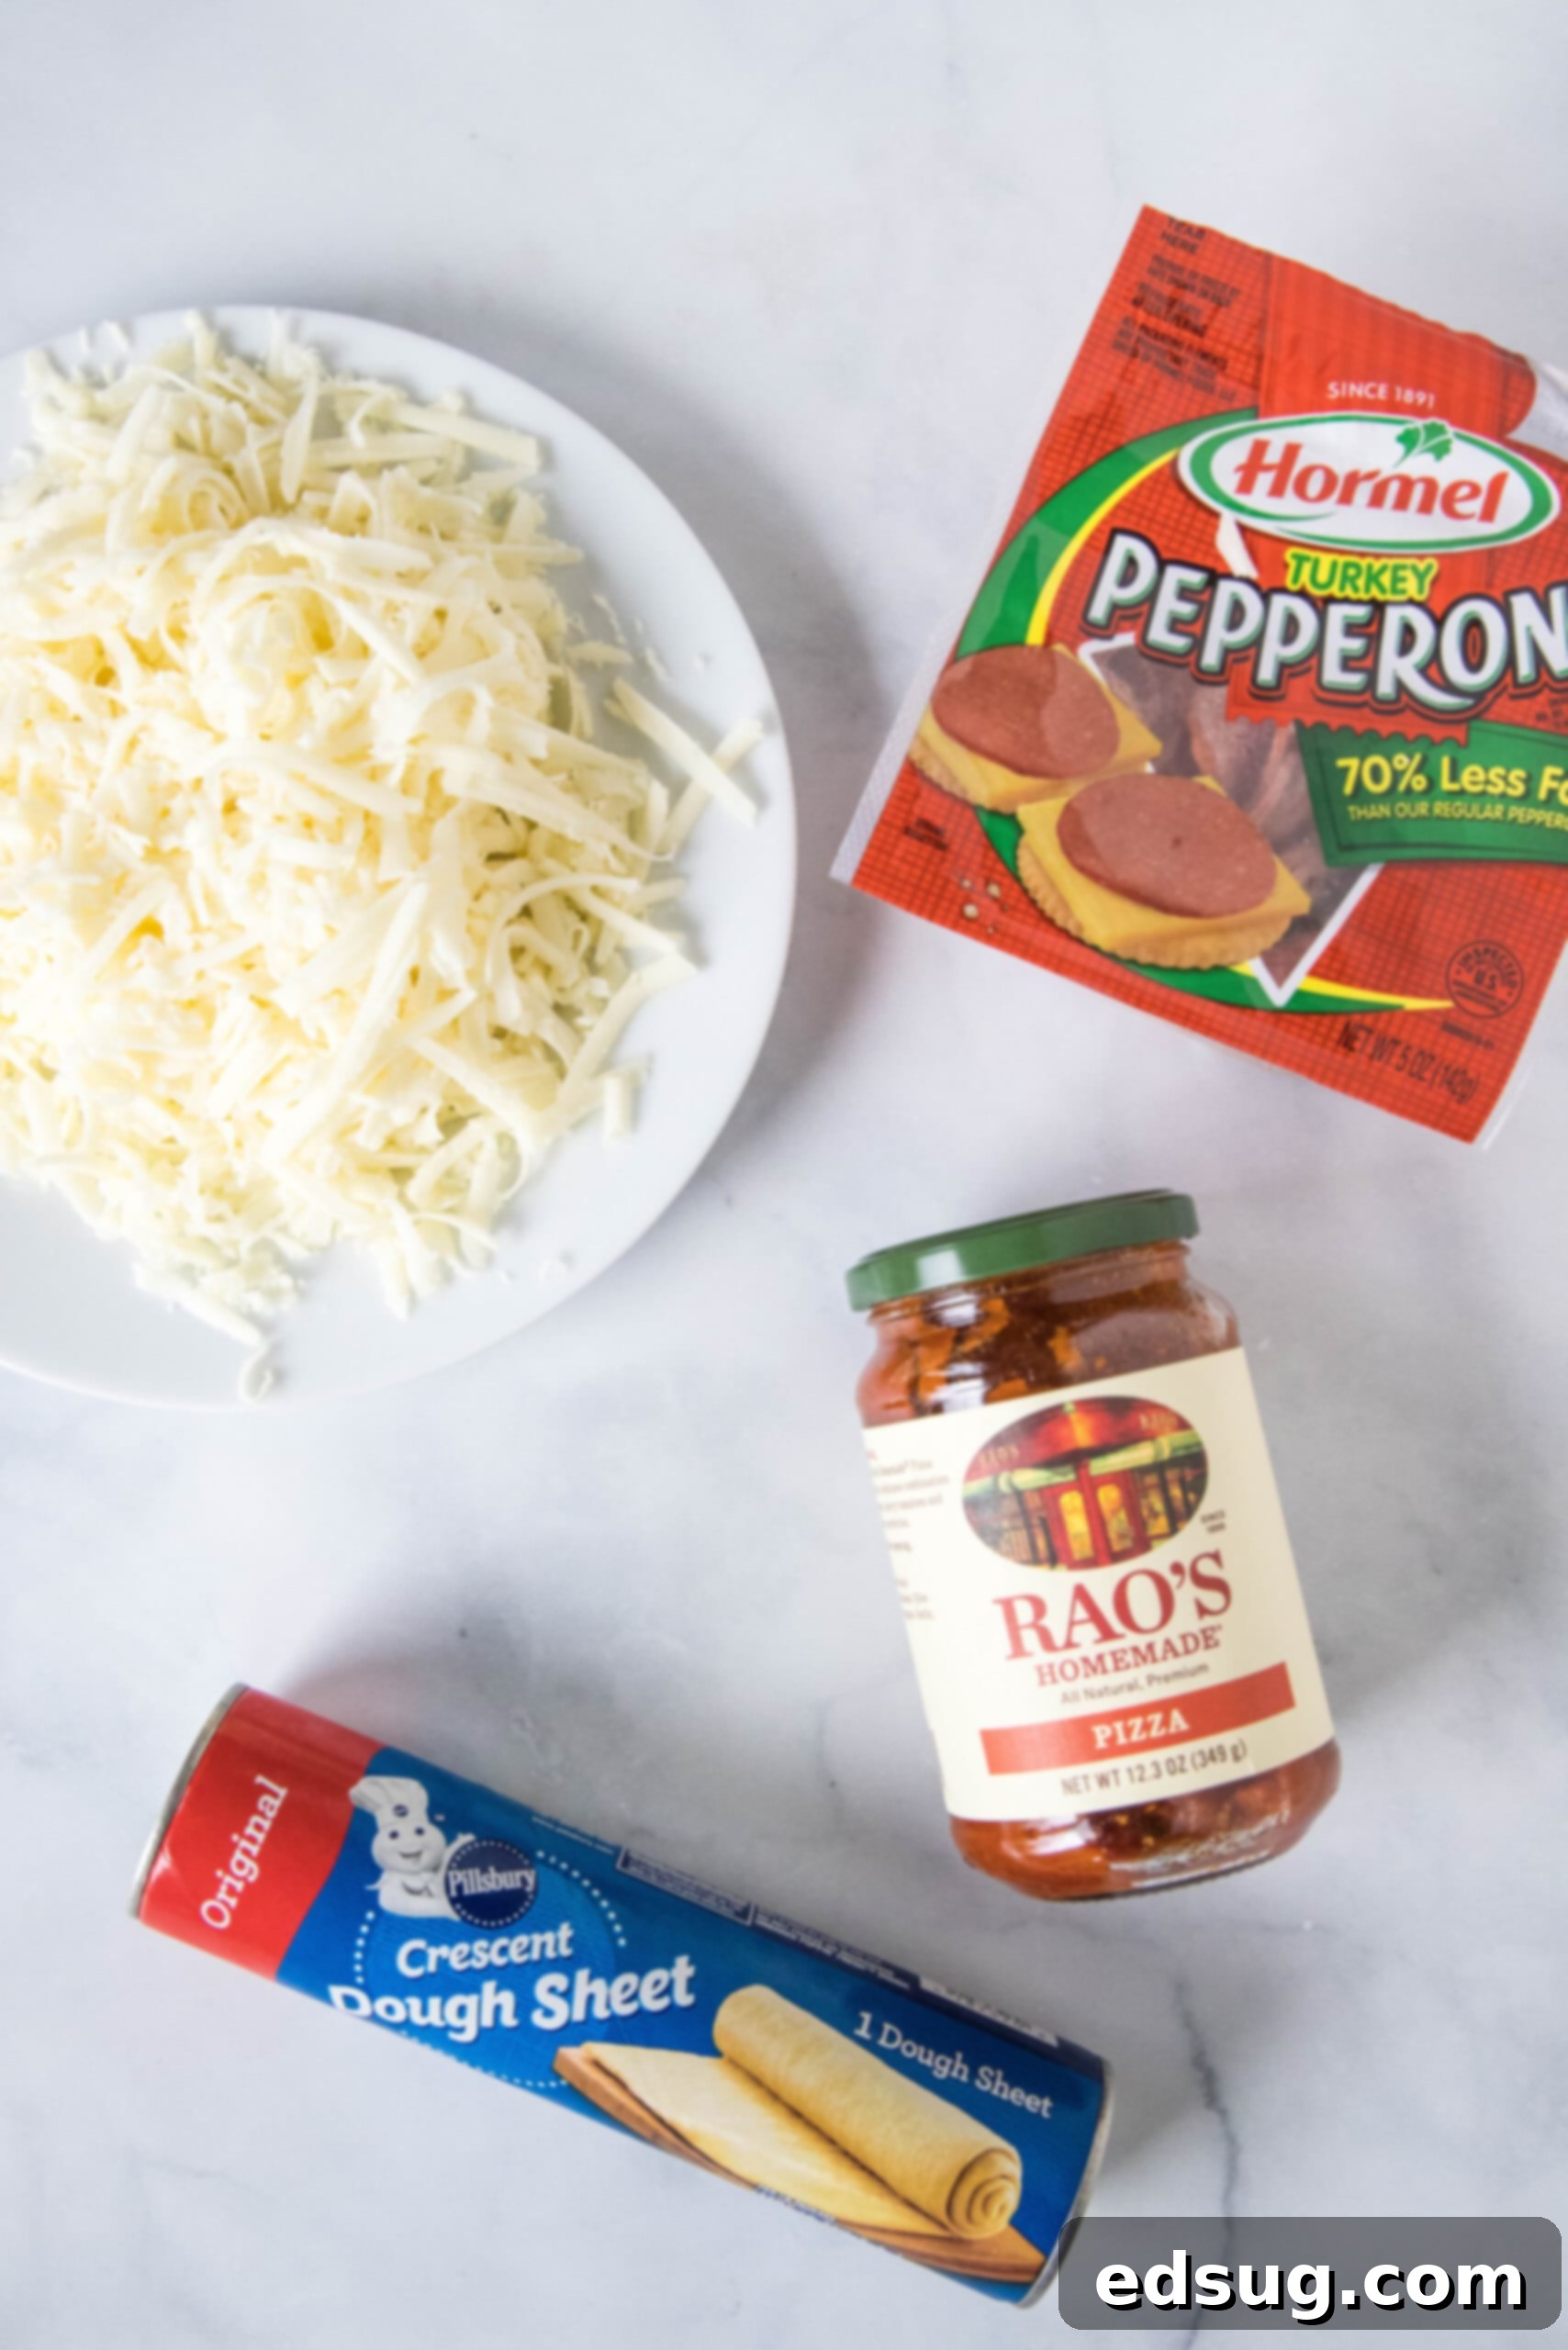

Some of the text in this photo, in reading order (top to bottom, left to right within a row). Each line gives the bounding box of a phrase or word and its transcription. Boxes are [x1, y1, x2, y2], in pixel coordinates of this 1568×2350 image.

[1327, 381, 1435, 408] SINCE 1891
[1234, 438, 1508, 523] Hormel
[1290, 551, 1434, 597] TURKEY
[1337, 752, 1428, 796] 70%
[1440, 755, 1527, 798] Less
[1348, 804, 1391, 821] THAN
[1394, 801, 1428, 819] OUR
[1433, 800, 1506, 821] REGULAR
[1337, 1020, 1373, 1053] NET
[1395, 1045, 1412, 1071] 5
[992, 1549, 1232, 1661] RAO'S
[1060, 1662, 1210, 1705] All Natural, Premium
[1092, 1708, 1190, 1750] PIZZA
[1061, 1739, 1248, 1796] NET WT 12.3 OZ (349 g)
[199, 1774, 289, 1930] Original
[448, 1867, 536, 1898] Pillsbury
[396, 1921, 575, 1978] Crescent
[328, 1955, 697, 2044] Dough Sheet
[853, 2011, 873, 2041] 1
[878, 2022, 969, 2080] Dough
[974, 2065, 1054, 2119] Sheet
